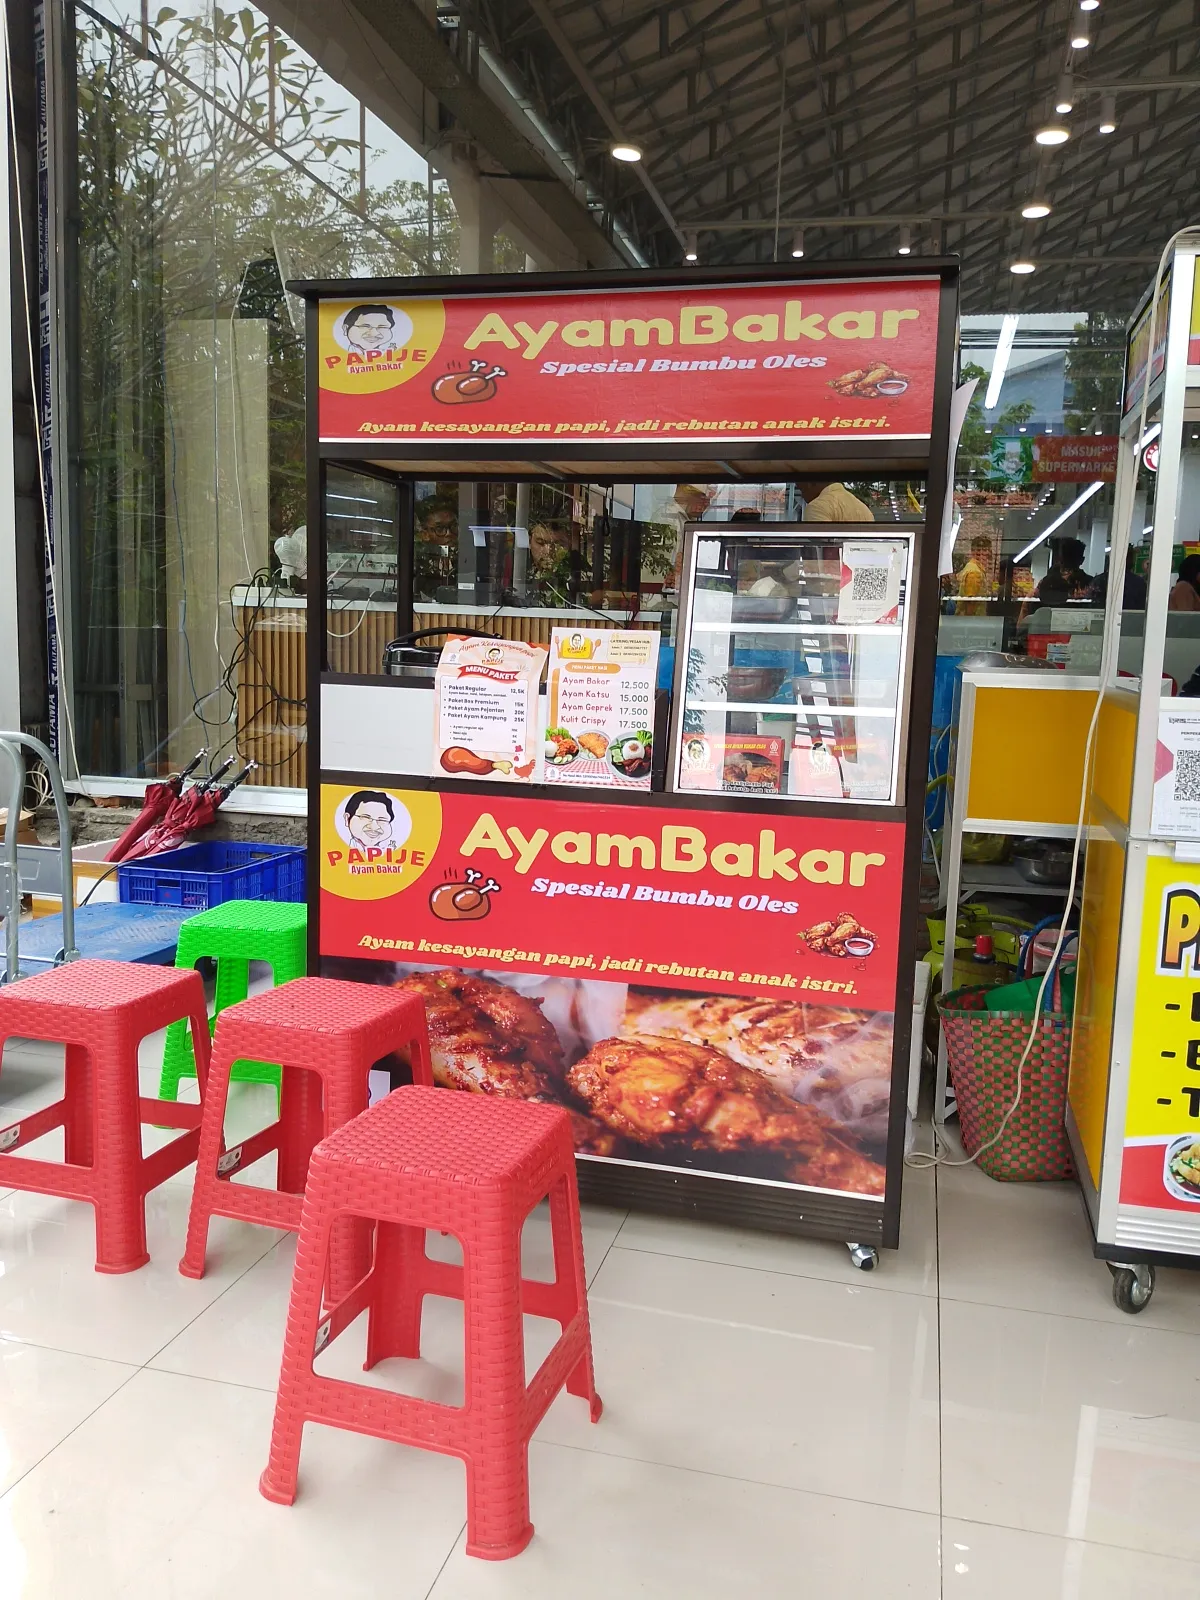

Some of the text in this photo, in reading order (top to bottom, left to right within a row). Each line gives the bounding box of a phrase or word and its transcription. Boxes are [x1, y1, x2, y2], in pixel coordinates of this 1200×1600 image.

[39, 80, 47, 123] ALUTAMA
[463, 299, 920, 360] AyamBakar
[324, 348, 428, 370] PAPIJE
[539, 353, 828, 377] Spesial Bumbu Oles
[350, 362, 402, 375] Ayam Bakar
[358, 415, 891, 435] Ayam kesayangan papi, jadi rebutan anak istri.
[1039, 461, 1116, 473] SUPERMARKE
[465, 665, 516, 680] MENU PAKET
[562, 676, 585, 686] Ayam
[586, 677, 611, 685] Bakar
[465, 685, 487, 693] Regular
[561, 689, 584, 699] Ayam
[585, 690, 610, 699] Katsu
[561, 702, 584, 711] Ayam
[585, 703, 613, 713] Geprek
[480, 714, 507, 722] Kampung
[560, 715, 579, 723] Kulit
[580, 716, 607, 726] Crispy
[326, 847, 426, 867] PAPIJE
[459, 812, 886, 888] AyamBakar
[351, 865, 402, 875] Ayam Bakar
[530, 876, 800, 915] Spesial Bumbu Oles
[1161, 888, 1200, 969] P
[357, 934, 858, 996] Ayam kesayangan papi, jadi rebutan anak istri.
